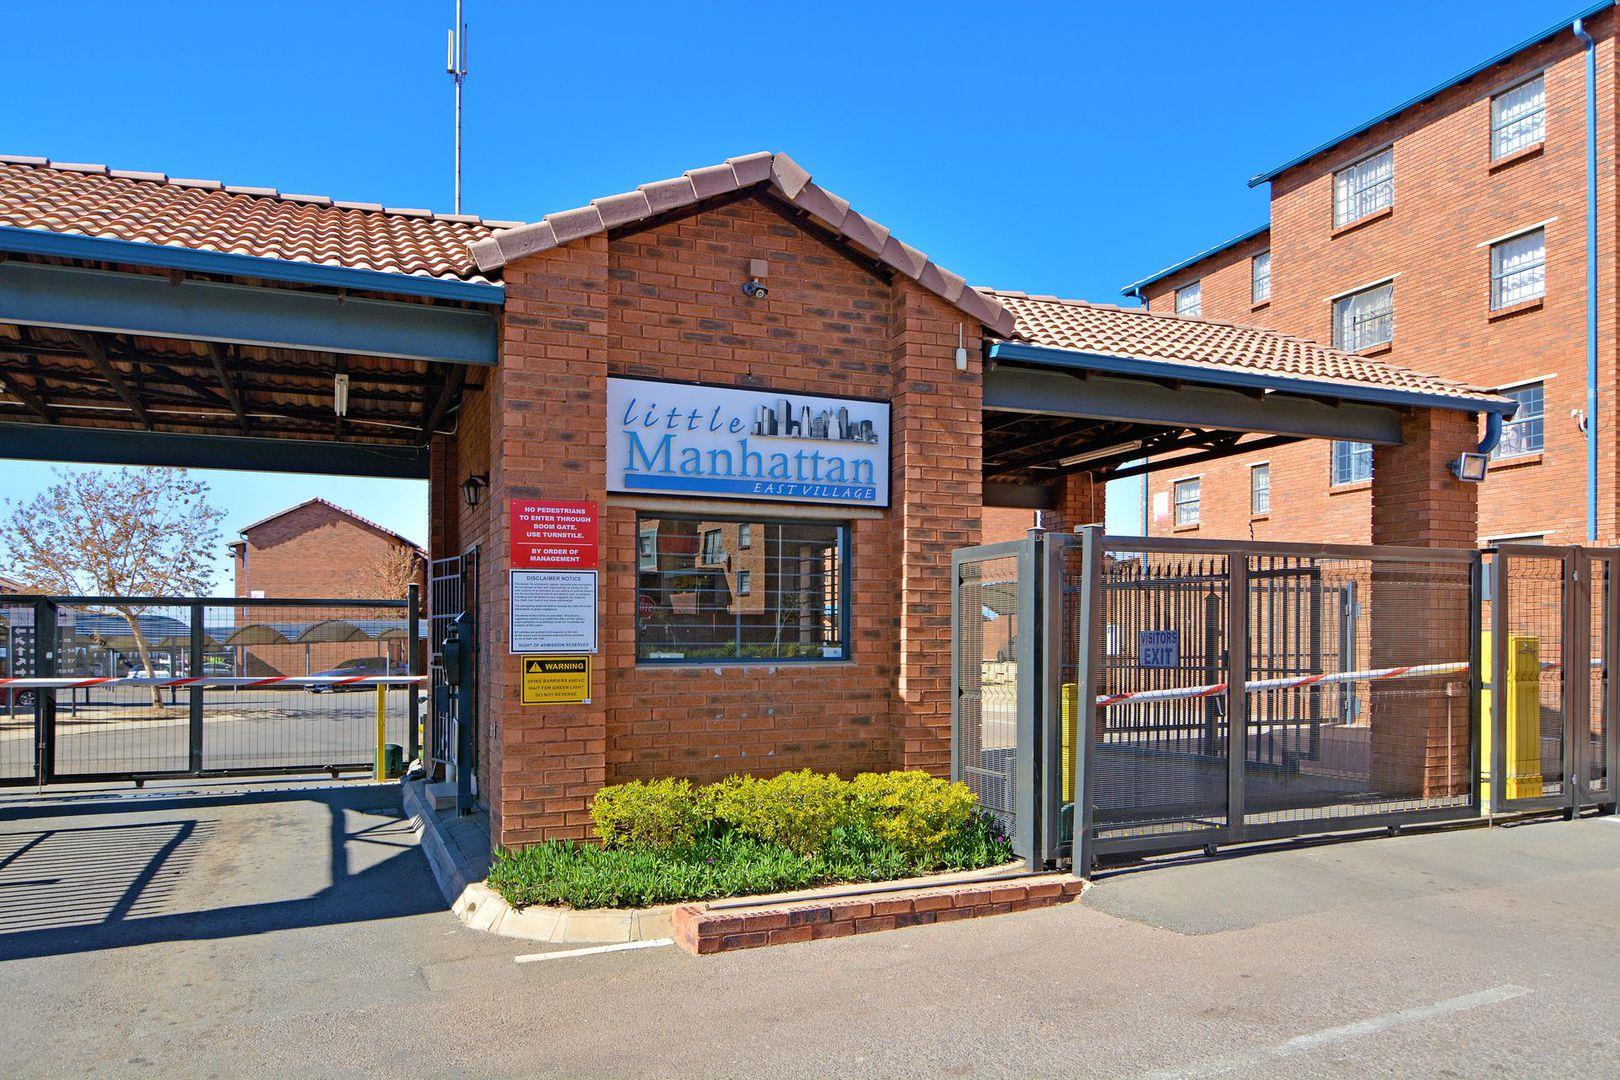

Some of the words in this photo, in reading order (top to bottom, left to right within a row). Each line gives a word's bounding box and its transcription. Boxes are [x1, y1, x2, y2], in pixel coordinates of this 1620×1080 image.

[623, 398, 746, 434] little
[623, 430, 877, 485] Manhattan
[753, 482, 797, 496] EAST
[802, 485, 874, 500] VILLAGE
[537, 506, 586, 515] PEDESTRIANS
[1140, 631, 1178, 644] VISITORS
[1144, 648, 1173, 665] EXIT
[545, 662, 584, 670] WARNING
